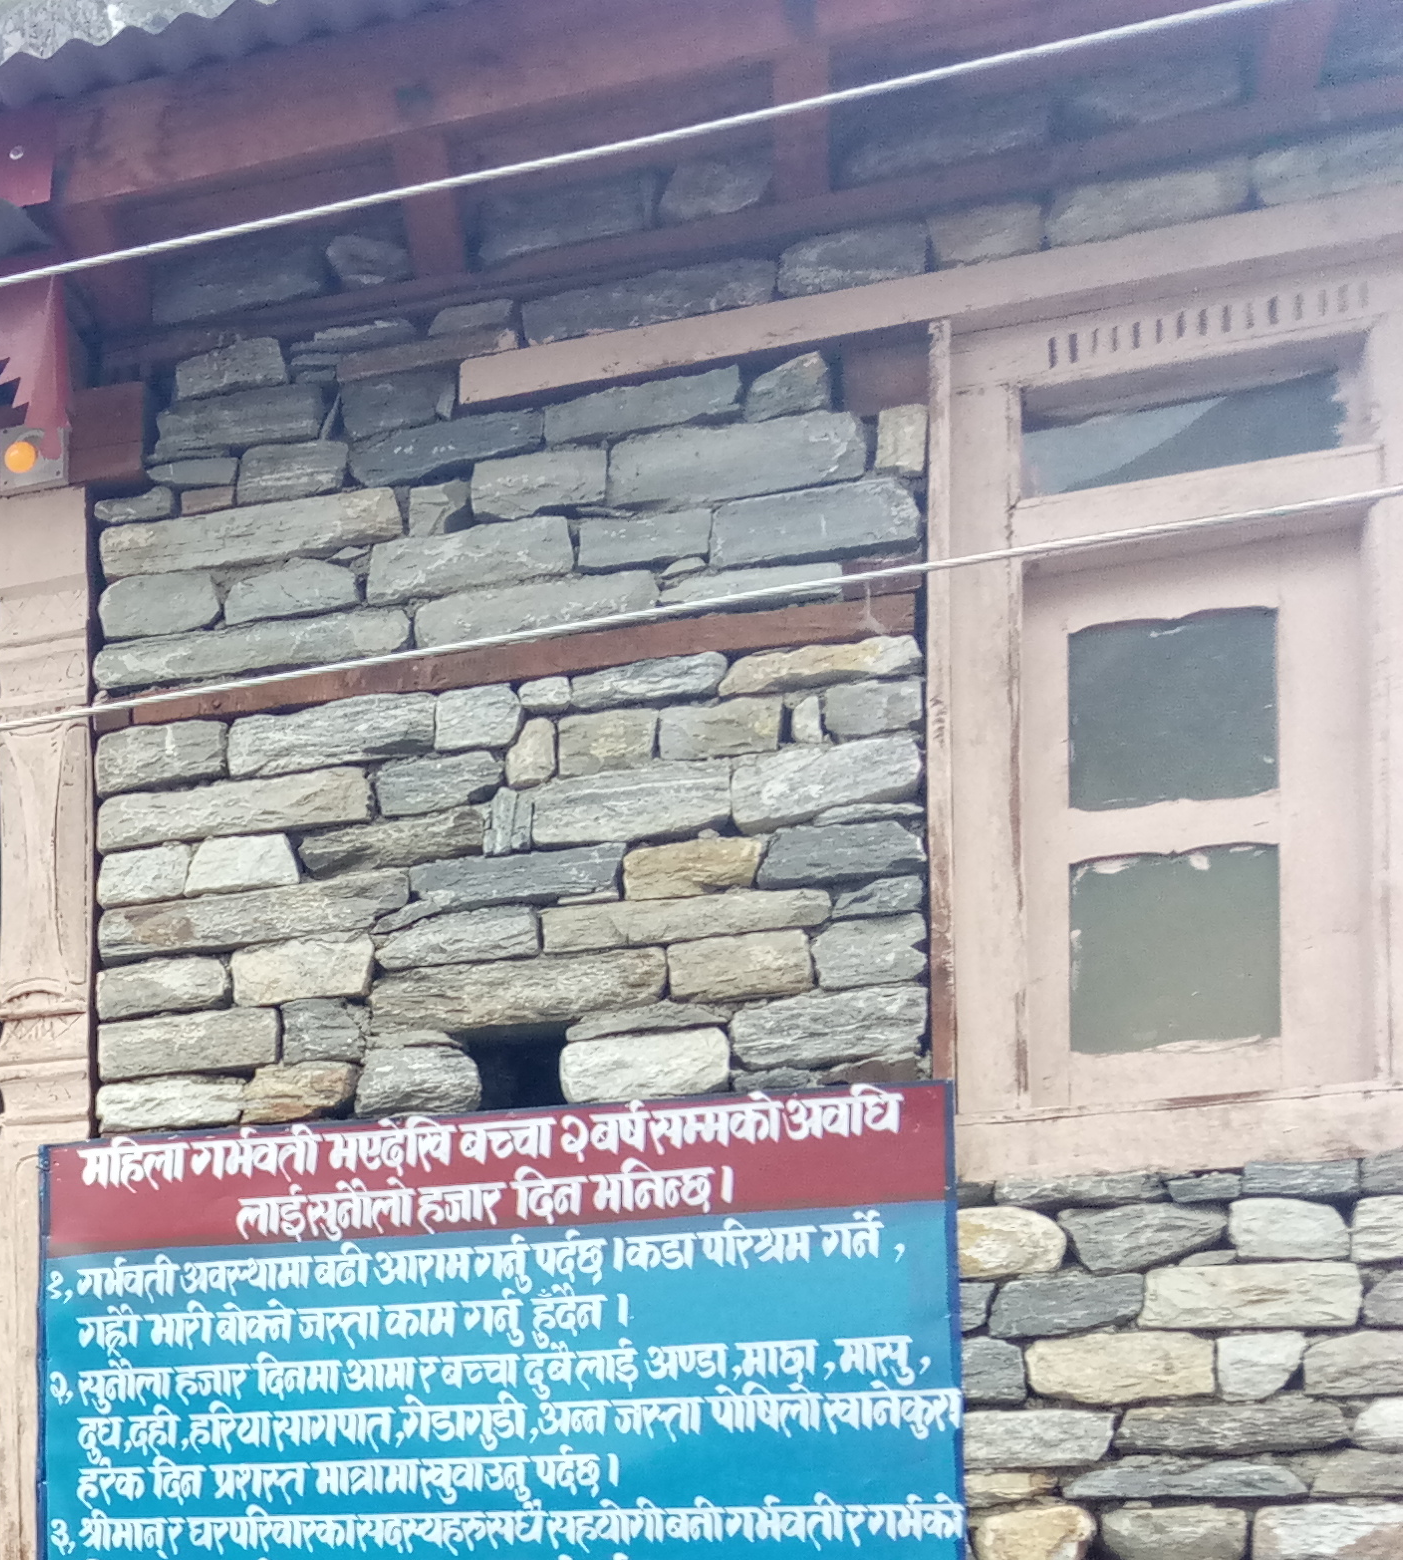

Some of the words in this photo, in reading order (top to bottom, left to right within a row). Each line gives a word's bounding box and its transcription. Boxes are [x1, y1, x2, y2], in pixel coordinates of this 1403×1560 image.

[77, 1136, 188, 1193] महिला
[190, 1124, 320, 1182] गर्भवती
[322, 1116, 460, 1177] भएदेखि
[459, 1116, 556, 1165] बच्चा
[418, 1181, 508, 1234] हजार
[511, 1165, 587, 1225] दिन
[76, 1256, 180, 1304] गर्भवती
[179, 1255, 315, 1297] अवस्थामा
[313, 1241, 373, 1288] बढी
[372, 1246, 476, 1287] आराम
[472, 1233, 533, 1295] गर्नु
[625, 1232, 698, 1272] कडा
[697, 1218, 817, 1270] परिश्रम
[142, 1301, 218, 1350] भारी
[216, 1298, 296, 1346] बोक्ने
[296, 1304, 383, 1349] जस्ता
[382, 1301, 461, 1338] काम
[462, 1289, 524, 1347] गर्नु
[175, 1363, 251, 1407] हजार
[252, 1351, 342, 1400] दिनमा
[440, 1354, 522, 1390] बच्चा
[611, 1396, 706, 1442] जस्ता
[76, 1458, 146, 1508] हरेक
[147, 1456, 207, 1505] दिन
[210, 1461, 310, 1504] प्रशस्त
[725, 1492, 846, 1551] गर्भवती
